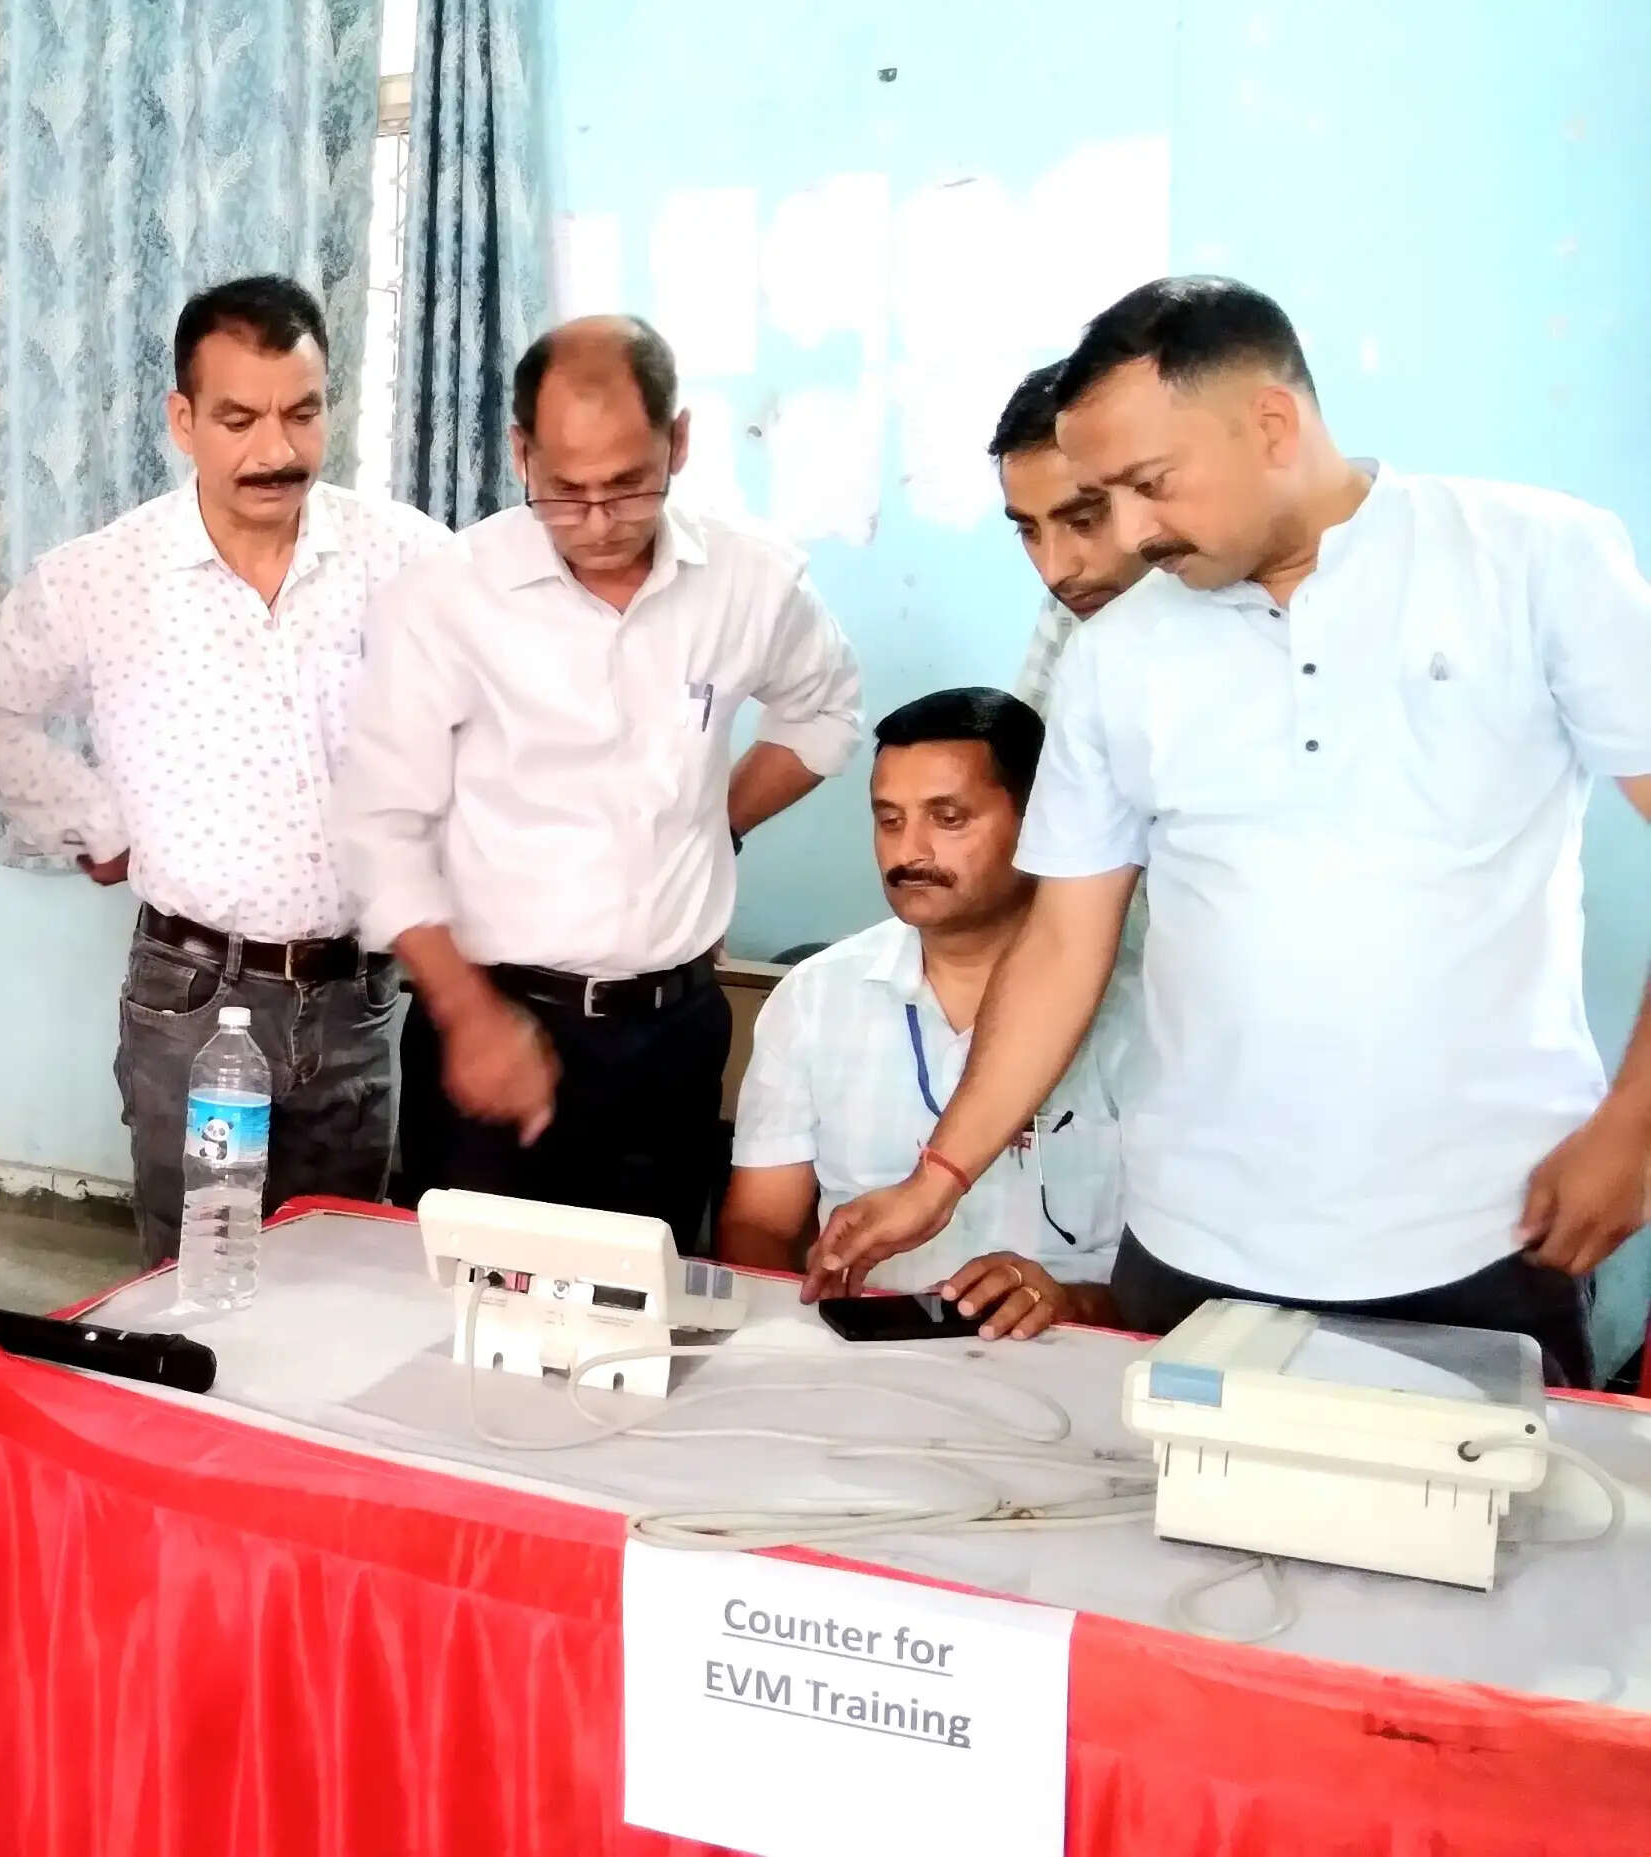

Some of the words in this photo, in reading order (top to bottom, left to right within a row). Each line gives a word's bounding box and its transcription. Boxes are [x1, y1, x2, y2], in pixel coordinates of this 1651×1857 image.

[724, 1598, 882, 1654] Counter
[894, 1626, 954, 1667] for
[706, 1660, 791, 1705] EVM
[805, 1678, 971, 1748] Training
